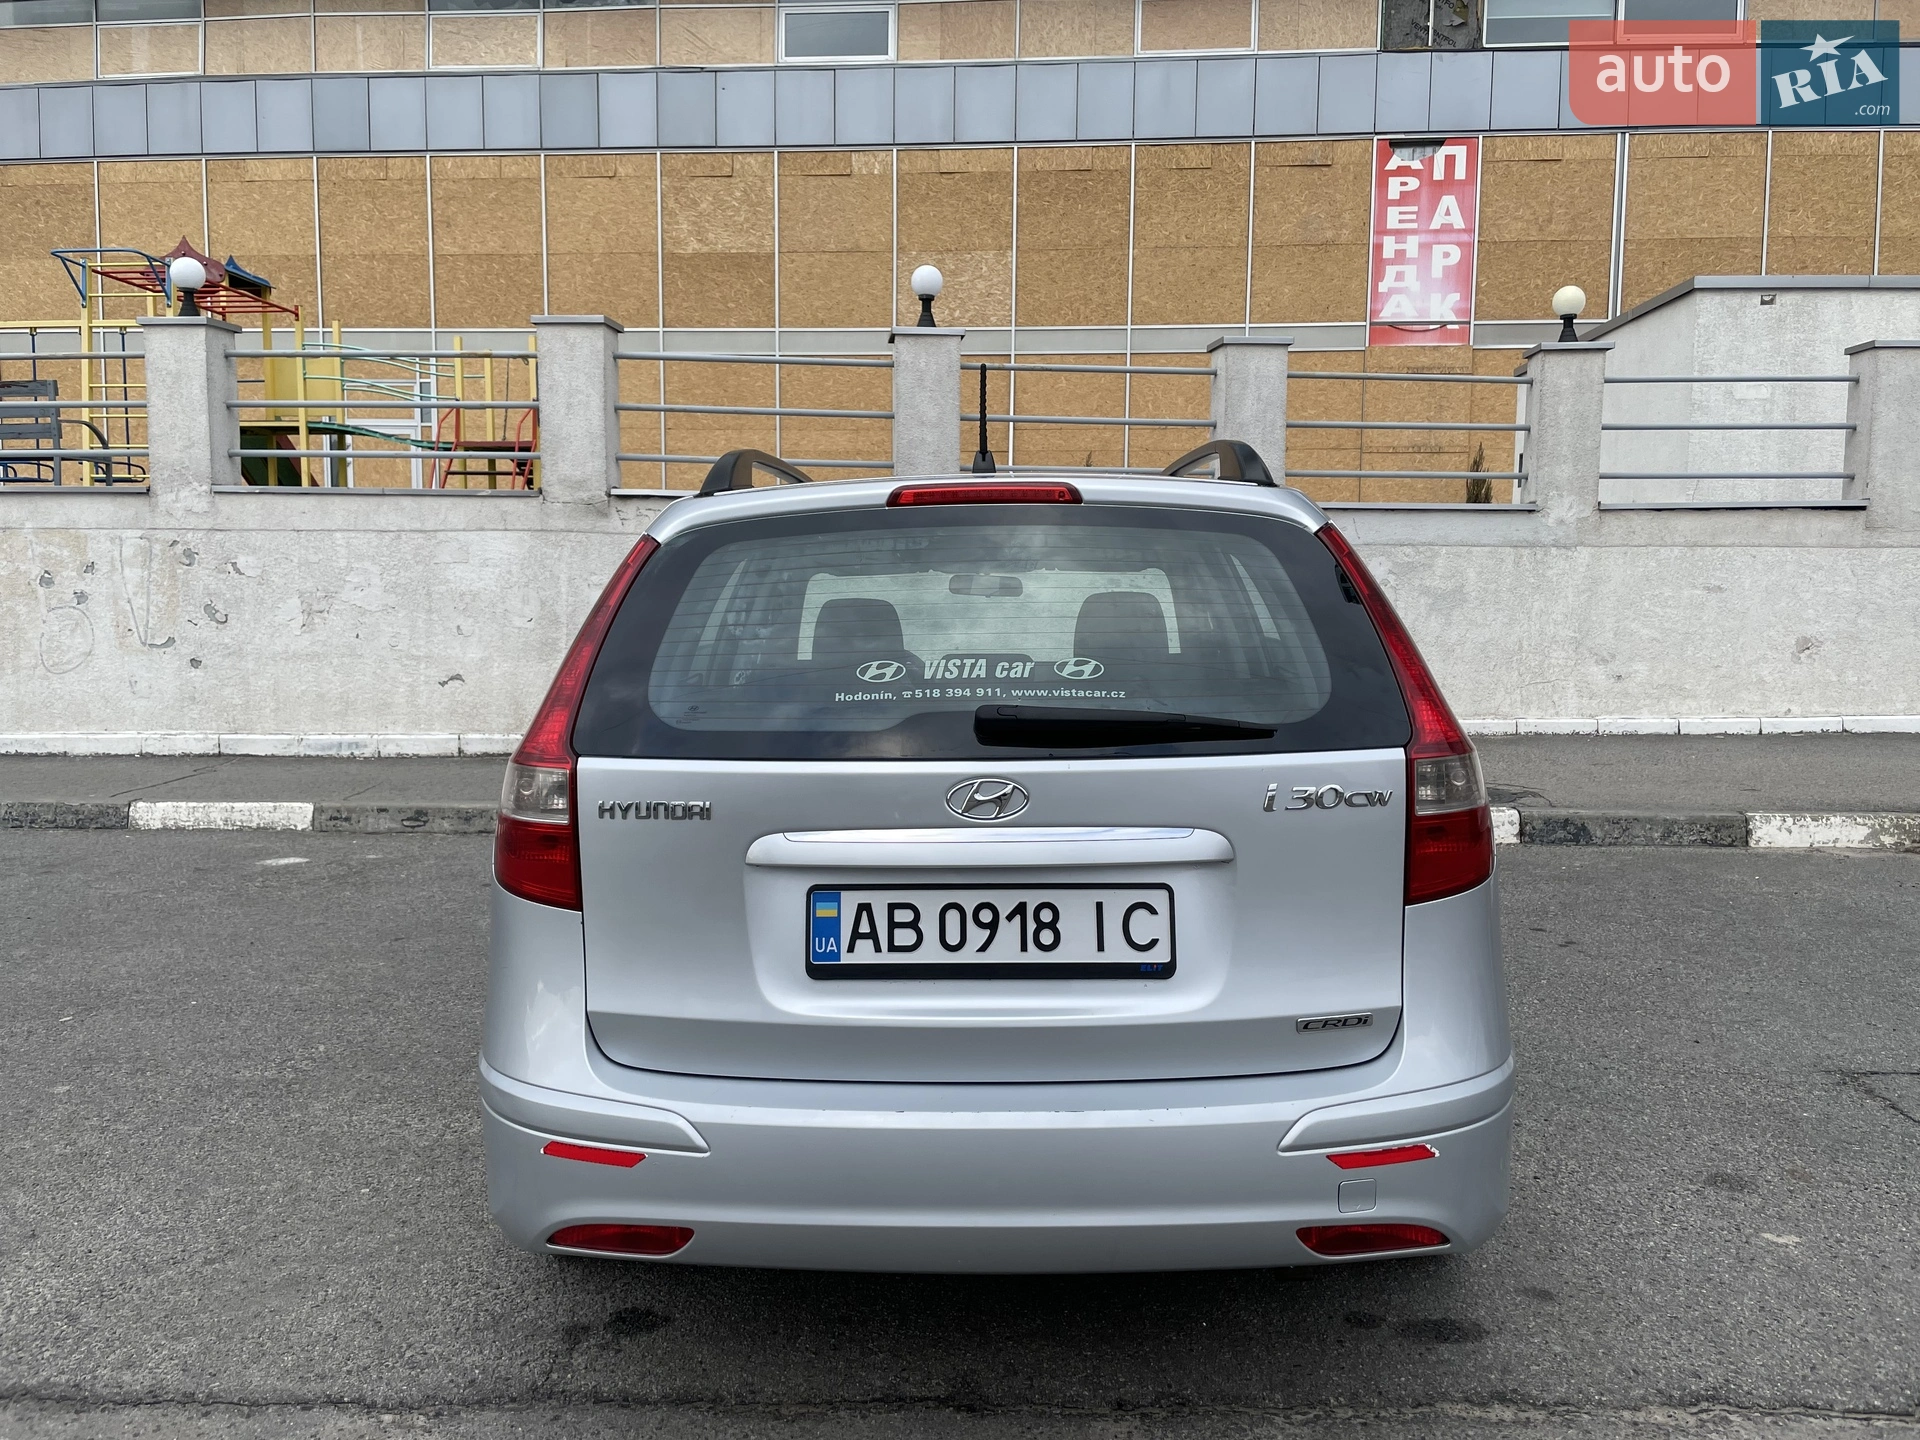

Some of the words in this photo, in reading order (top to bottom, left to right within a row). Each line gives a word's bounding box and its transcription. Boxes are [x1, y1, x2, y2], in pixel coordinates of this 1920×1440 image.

[1428, 145, 1468, 330] ПАРК
[923, 658, 987, 679] VISTA
[995, 661, 1035, 679] car
[834, 690, 897, 702] Hodonín,
[945, 688, 972, 698] 394
[976, 687, 1007, 698] 911,
[1011, 687, 1127, 698] www.vistacar.cz
[598, 800, 711, 821] HYUNDAI
[815, 937, 838, 953] UA
[846, 902, 924, 953] AB
[938, 901, 1061, 953] 0918
[1302, 1016, 1370, 1030] CRDi
